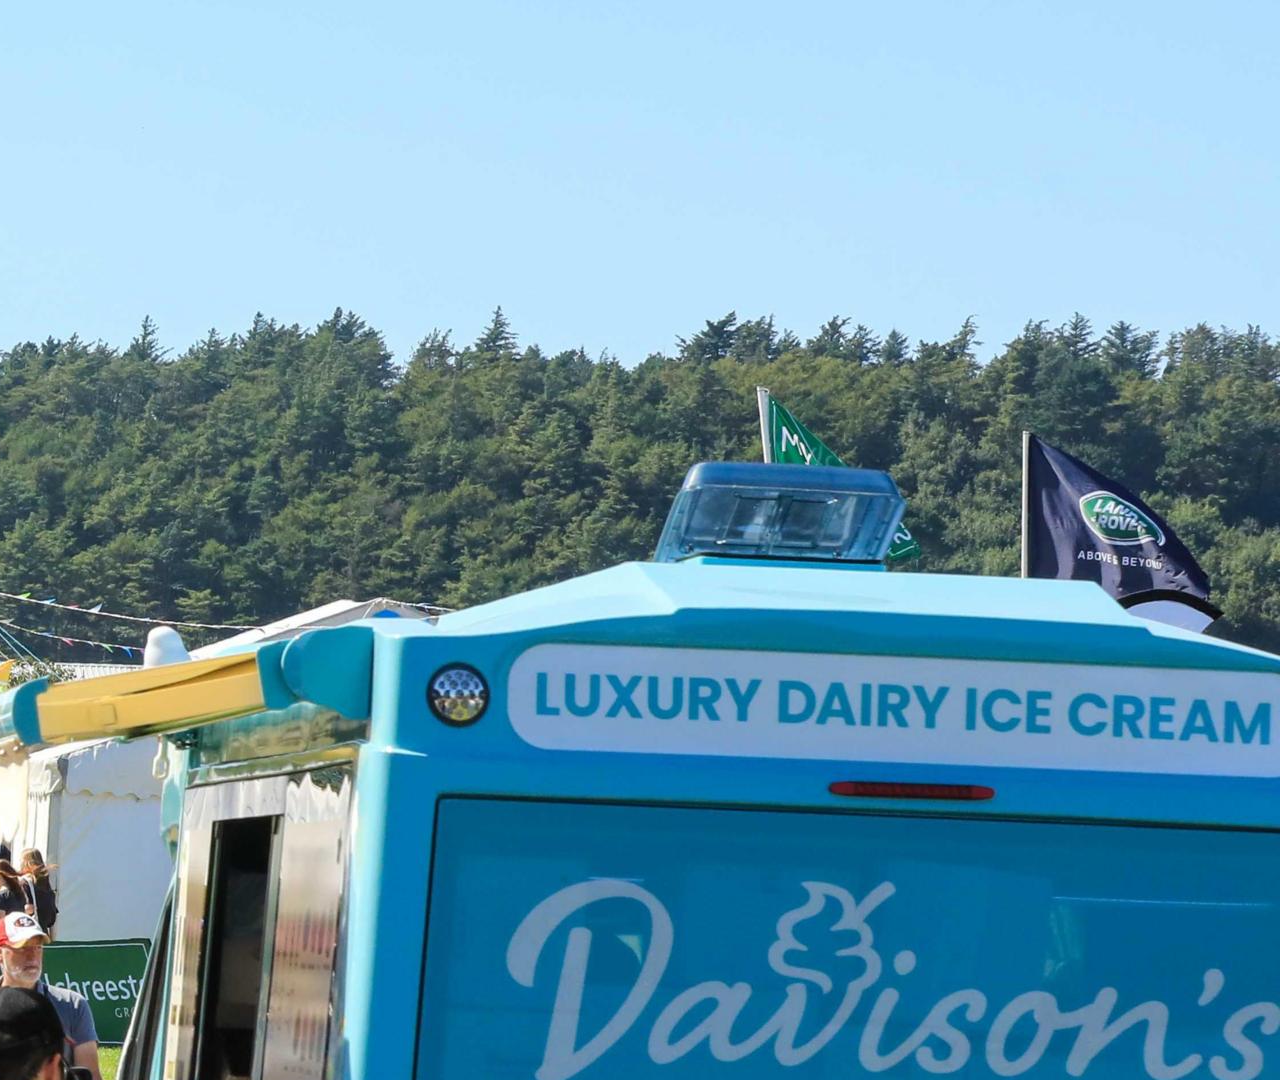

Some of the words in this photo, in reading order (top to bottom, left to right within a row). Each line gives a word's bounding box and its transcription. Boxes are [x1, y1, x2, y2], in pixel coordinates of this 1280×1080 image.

[1093, 498, 1138, 521] LAND
[1077, 550, 1112, 563] ABOVE
[534, 672, 762, 723] LUXURY
[777, 680, 951, 730] DAIRY
[965, 687, 1052, 735] ICE
[1067, 692, 1273, 746] CREAM
